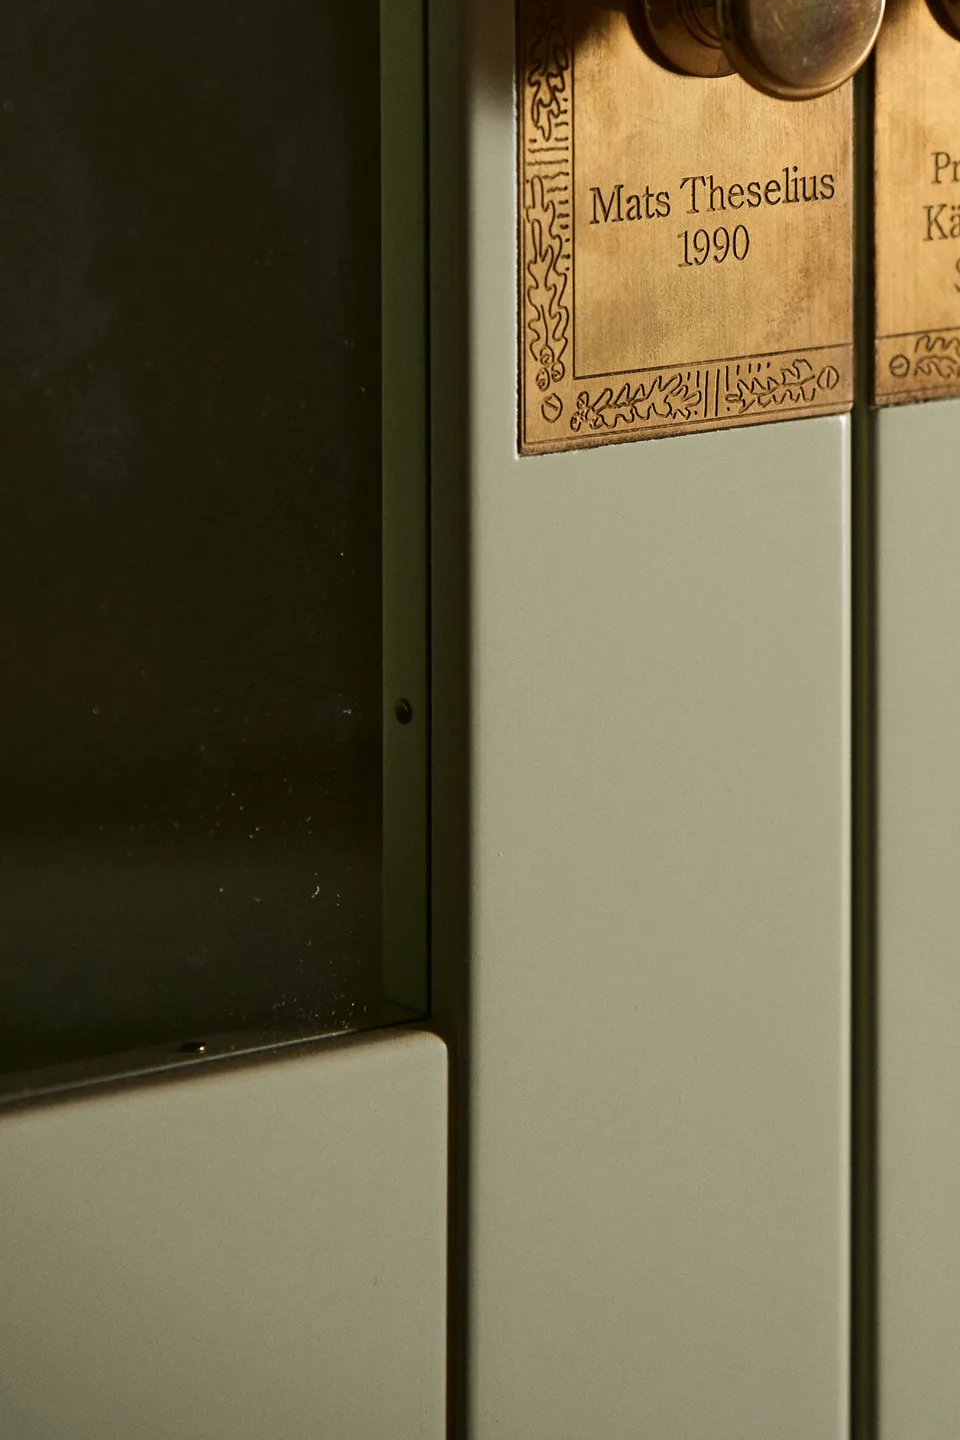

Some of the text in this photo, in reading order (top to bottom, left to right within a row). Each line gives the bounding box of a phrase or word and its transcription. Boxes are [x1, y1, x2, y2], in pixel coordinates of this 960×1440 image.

[589, 165, 835, 225] Mats Theselius
[677, 224, 750, 268] 1990
